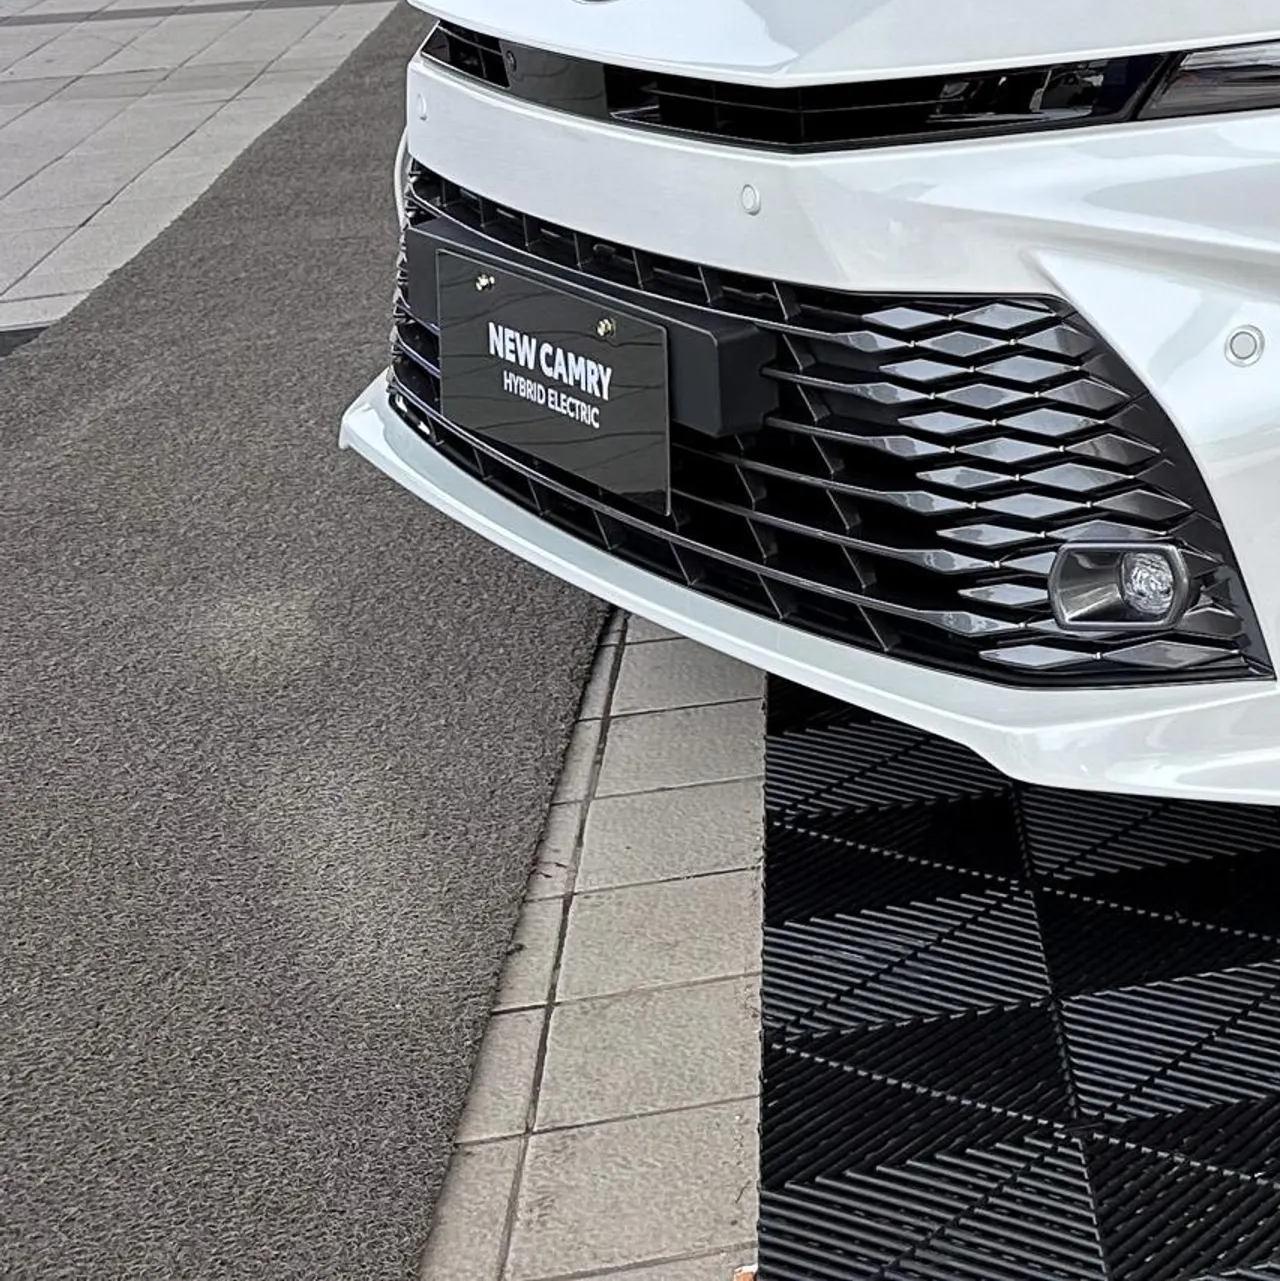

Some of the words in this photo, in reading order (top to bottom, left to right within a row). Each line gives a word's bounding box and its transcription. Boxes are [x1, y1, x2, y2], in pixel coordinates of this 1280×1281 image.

[488, 322, 536, 370] NEW
[540, 343, 612, 400] CAMRY
[503, 370, 546, 405] HYBRID
[547, 388, 600, 429] ELECTRIC
